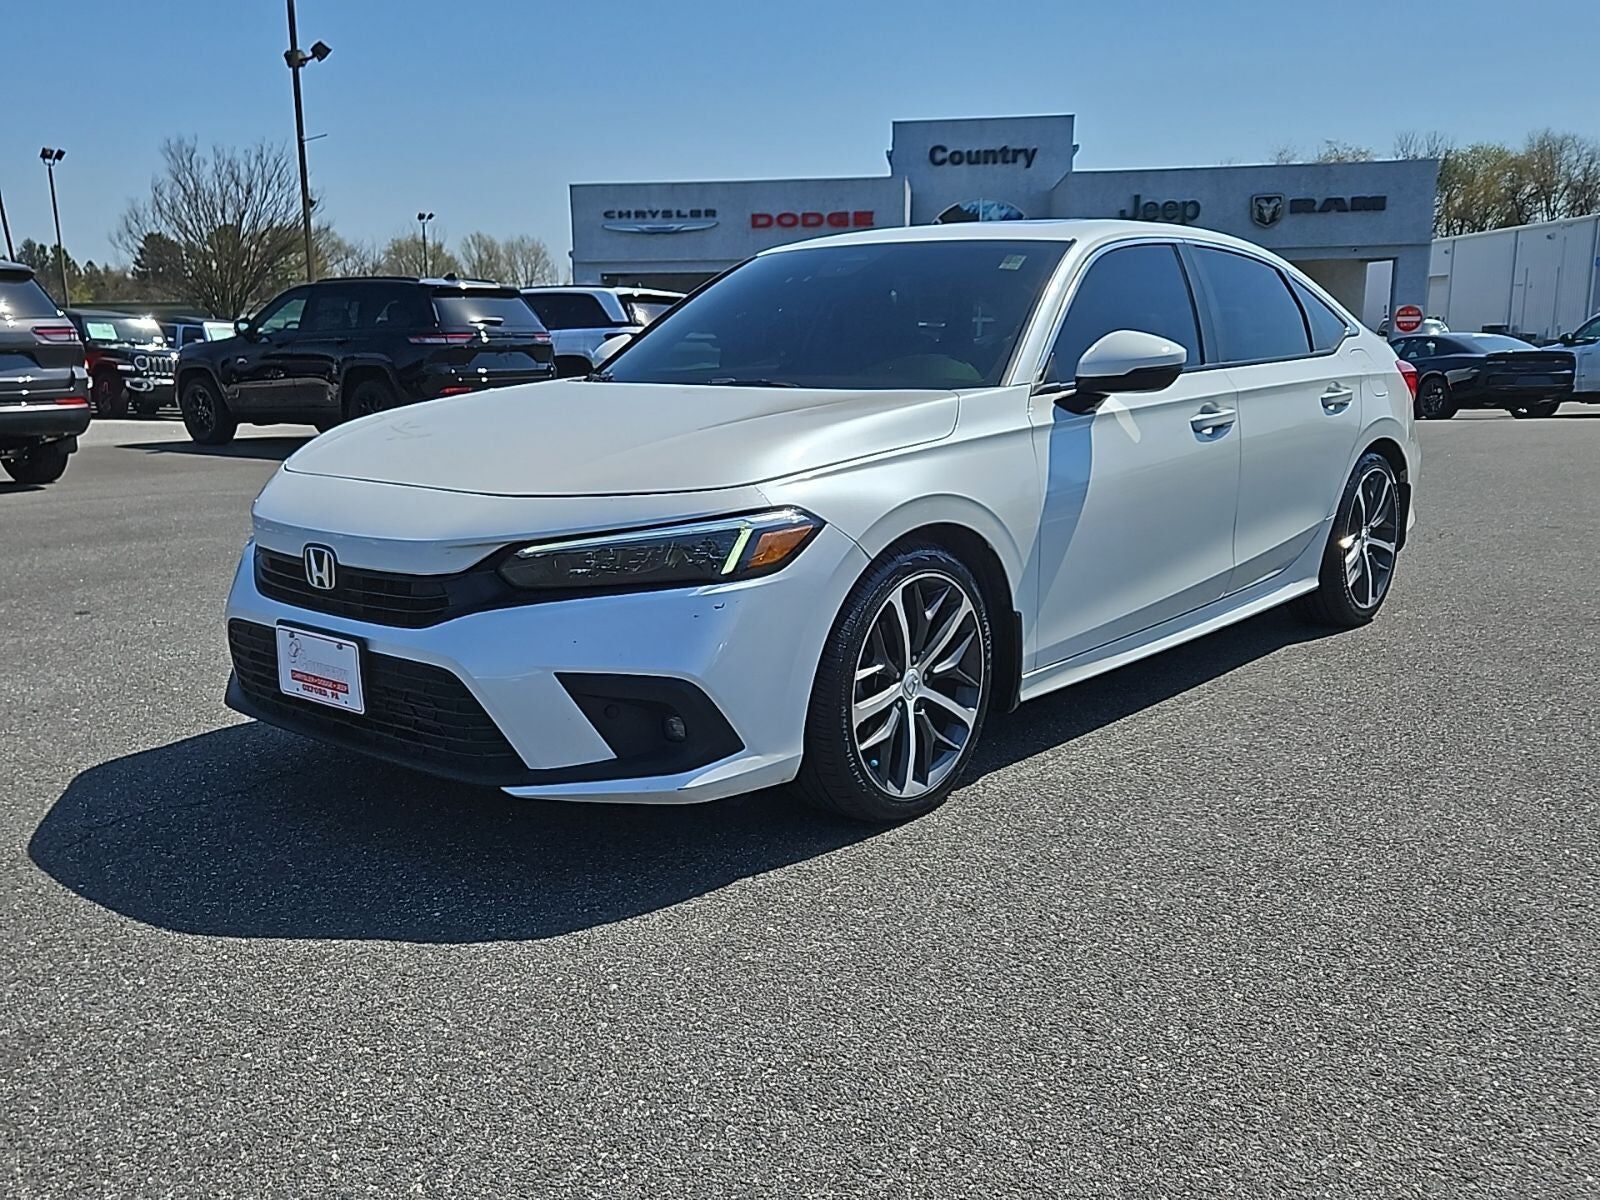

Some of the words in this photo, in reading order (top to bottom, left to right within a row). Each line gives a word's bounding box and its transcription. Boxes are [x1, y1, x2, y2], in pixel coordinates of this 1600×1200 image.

[929, 144, 1038, 169] Country
[603, 209, 717, 219] CHRYSLER
[1119, 194, 1201, 224] Jeep
[1289, 196, 1387, 214] RAM
[751, 211, 874, 228] DODGE
